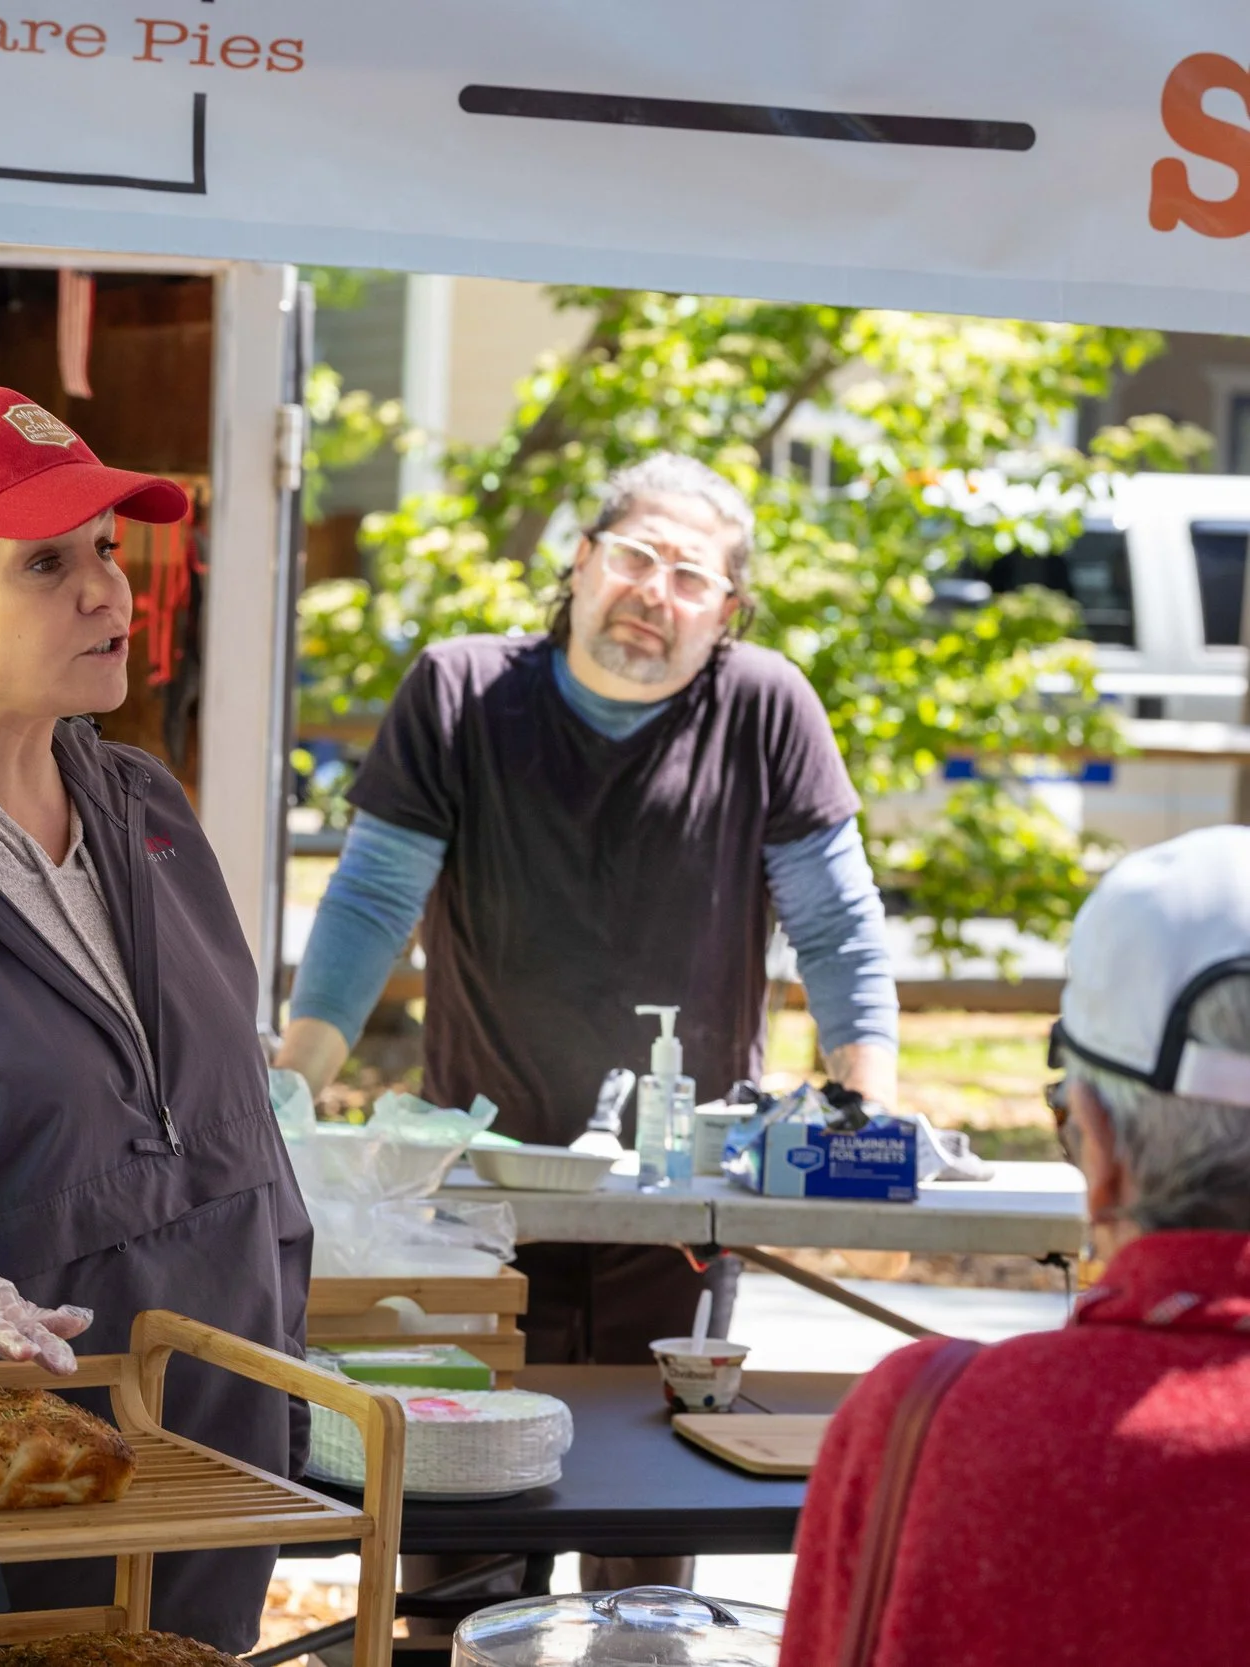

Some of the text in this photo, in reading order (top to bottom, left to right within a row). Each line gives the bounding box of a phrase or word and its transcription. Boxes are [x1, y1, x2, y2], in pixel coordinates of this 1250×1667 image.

[132, 18, 305, 73] Pies
[830, 1136, 906, 1150] ALUMINUM
[829, 1149, 857, 1162] FOIL
[859, 1150, 907, 1164] SHEETS
